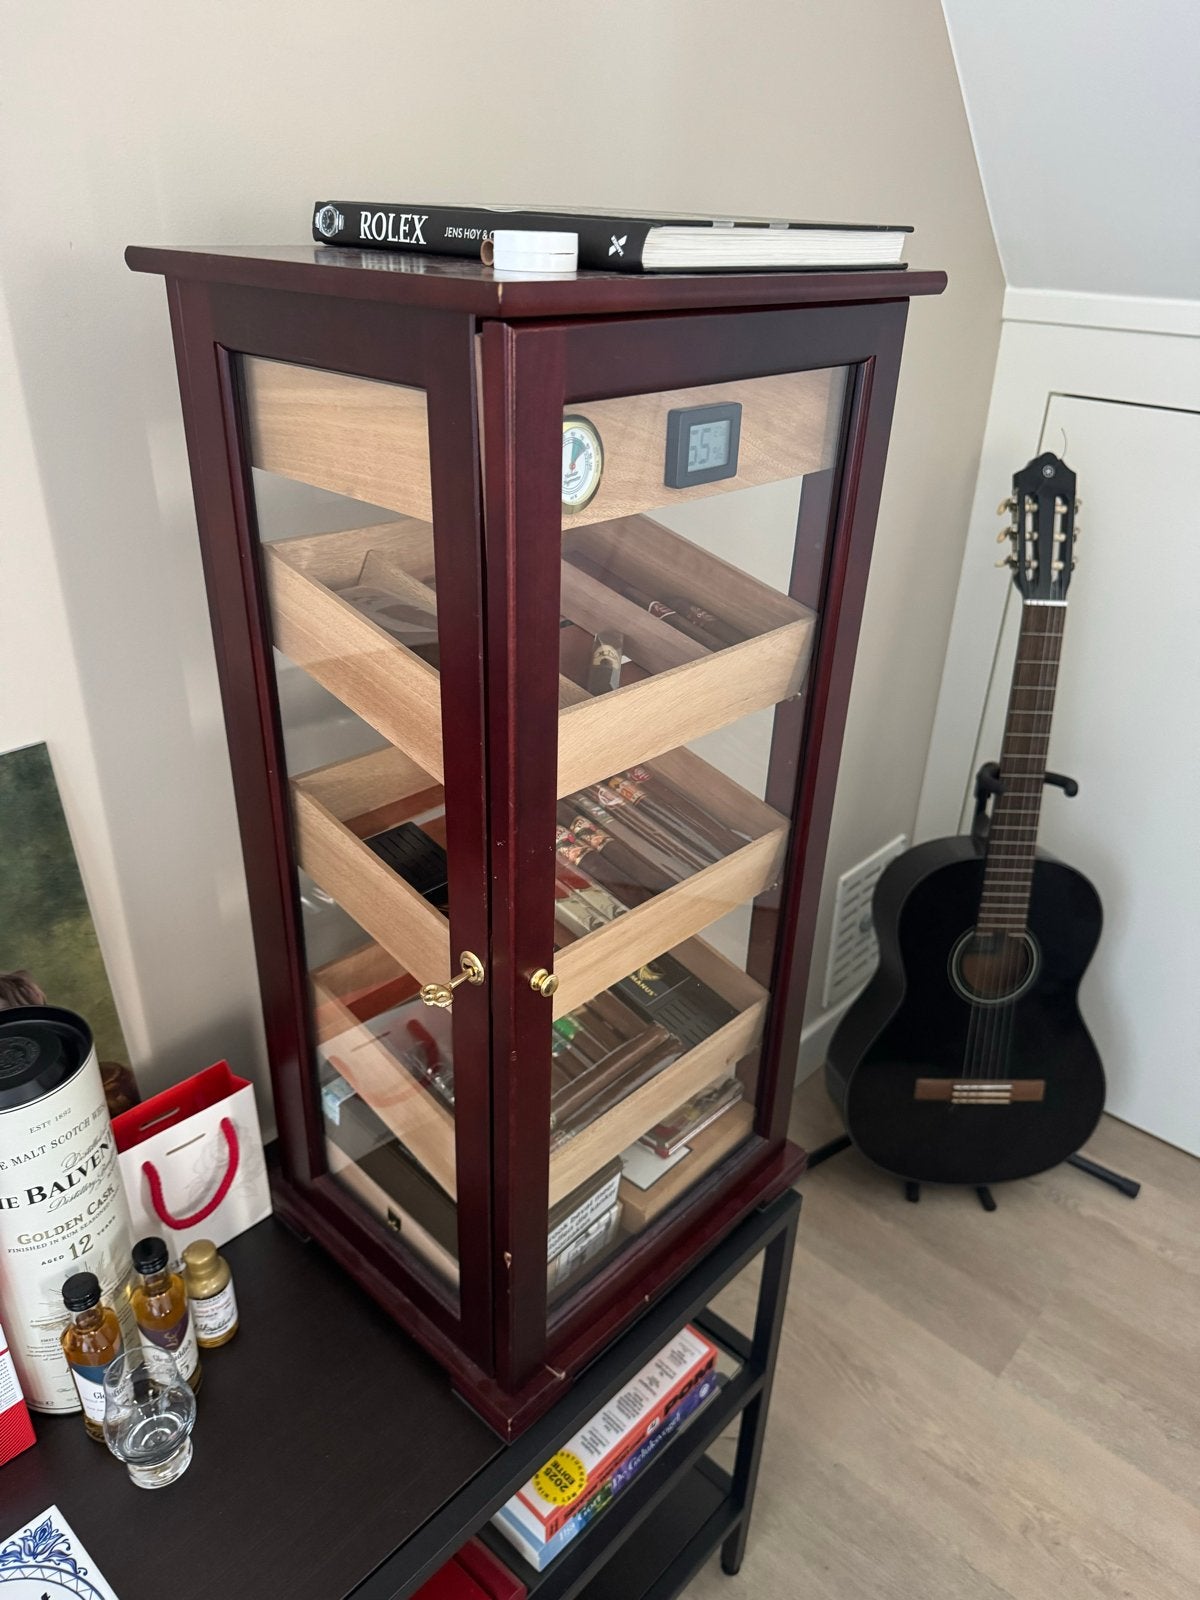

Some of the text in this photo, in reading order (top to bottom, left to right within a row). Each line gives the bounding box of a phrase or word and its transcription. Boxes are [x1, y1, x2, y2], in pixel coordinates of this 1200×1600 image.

[359, 211, 429, 245] ROLEX
[444, 226, 463, 239] JENS
[464, 228, 482, 240] HØY
[482, 229, 488, 241] &
[10, 1116, 90, 1168] MALT SCOTCH
[17, 1213, 84, 1246] GOLDEN
[87, 1183, 115, 1216] CASK
[8, 1242, 48, 1254] FINISHED
[49, 1237, 59, 1246] IN
[62, 1229, 79, 1241] RUM
[41, 1254, 65, 1266] AGED
[68, 1233, 94, 1261] 12
[543, 1467, 568, 1493] 2025
[551, 1460, 576, 1486] EDITIE
